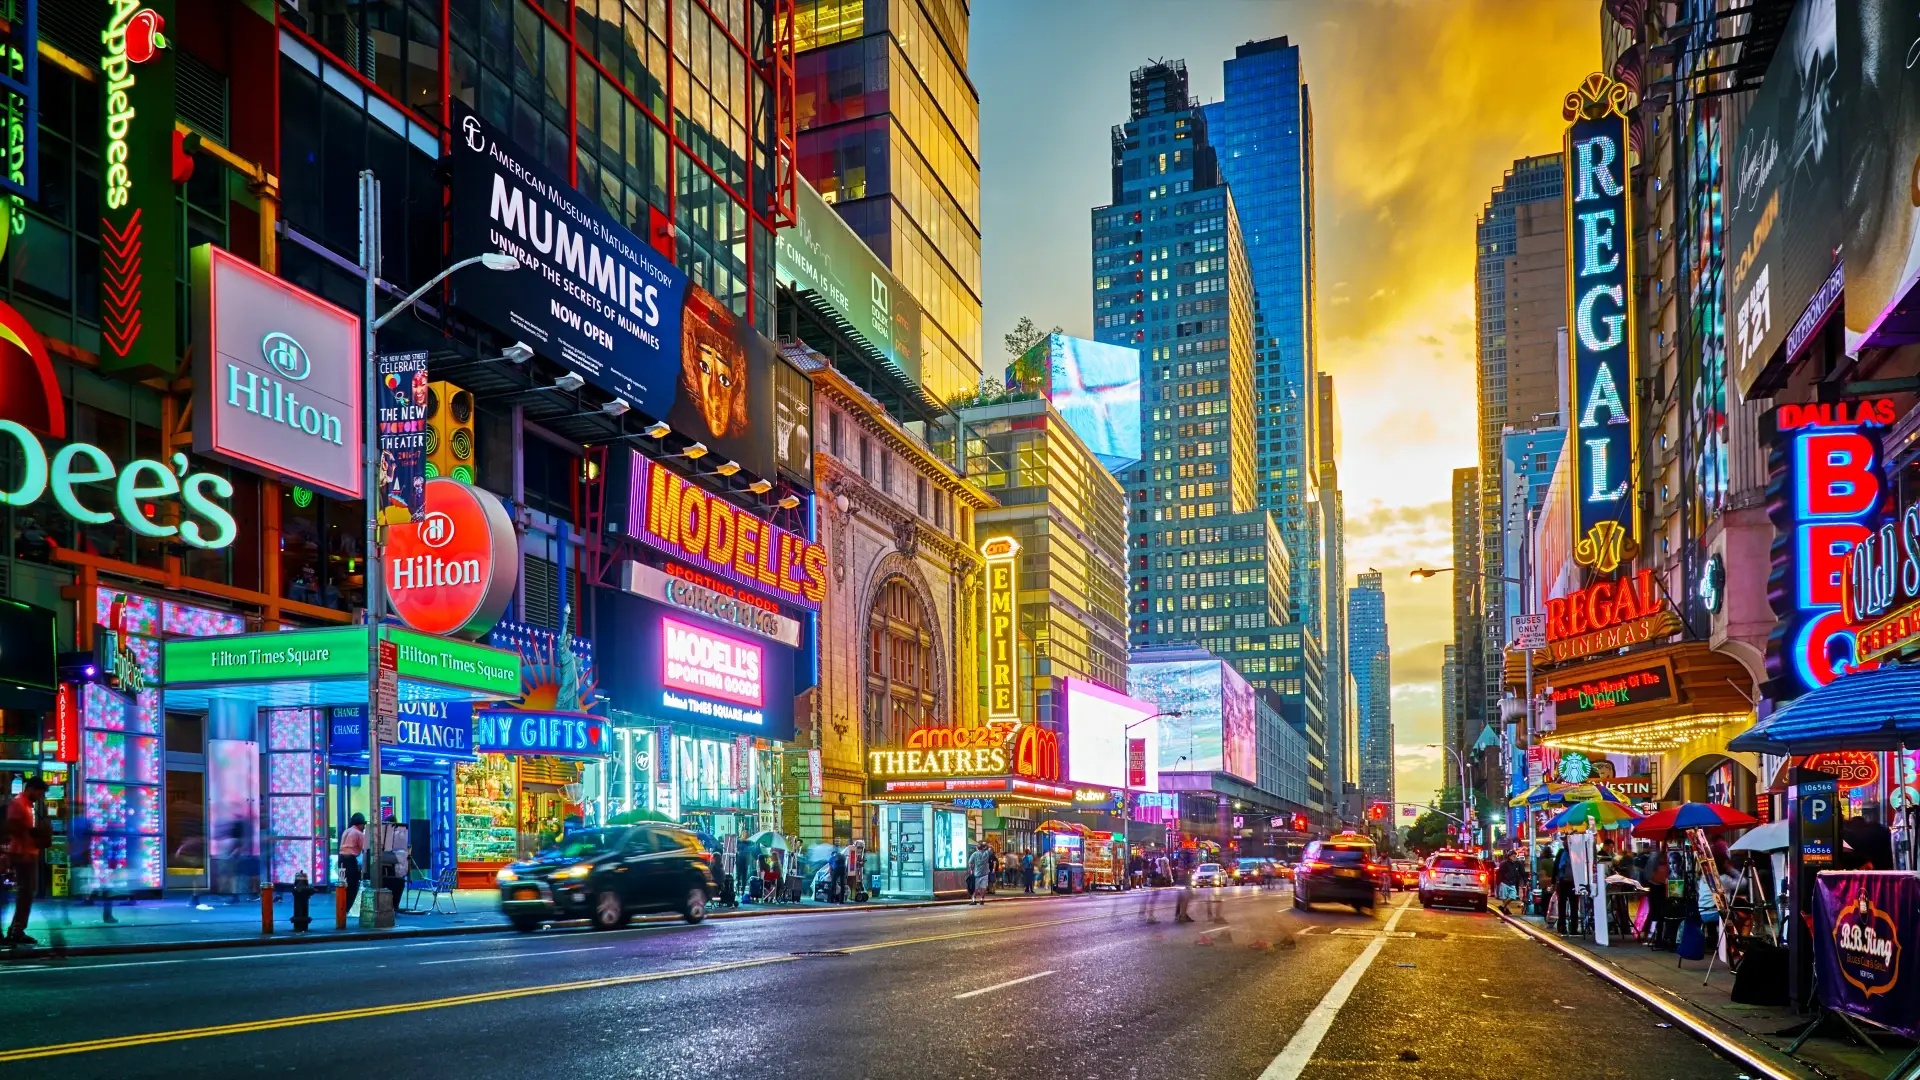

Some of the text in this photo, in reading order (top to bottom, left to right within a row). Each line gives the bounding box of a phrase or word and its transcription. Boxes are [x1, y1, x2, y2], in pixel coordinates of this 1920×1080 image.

[489, 141, 546, 197] AMERICAN
[548, 185, 592, 231] MUSEUM
[601, 225, 639, 267] NATURAL
[640, 255, 673, 289] HISTORY
[489, 173, 660, 328] MUMMIES
[490, 228, 660, 351] UNWRAP THE SECRETS OF MUMMIES
[786, 243, 818, 283] CINEMA
[820, 274, 828, 292] IS
[829, 282, 849, 312] HERE
[551, 299, 581, 331] NOW
[584, 320, 614, 351] OPEN
[871, 317, 889, 340] CINEMA
[1572, 135, 1630, 502] REGAL
[1738, 296, 1750, 332] NEW
[1738, 285, 1771, 372] 7.21
[1787, 288, 1827, 357] OUTFRONT
[380, 360, 426, 374] CELEBRATES
[412, 352, 426, 361] STREET
[227, 363, 343, 445] Hilton
[380, 406, 426, 422] THE NEW
[1778, 398, 1896, 431] DALLAS
[380, 420, 425, 433] VICTORY
[381, 437, 424, 450] THEATER
[650, 463, 828, 603] MODELL'S
[986, 542, 1012, 555] amc
[393, 555, 481, 590] Hilton
[1795, 431, 1882, 690] BBQ
[666, 562, 779, 614] SPORTING GOODS
[1544, 568, 1663, 642] REGAL
[1515, 616, 1541, 625] BUSES
[1518, 625, 1539, 633] ONLY
[667, 626, 760, 682] MODELL'S
[991, 567, 1012, 709] EMPIRE
[1557, 620, 1651, 660] CINEMAS
[212, 647, 330, 666] Hilton Times Square
[399, 644, 438, 666] Hilton
[439, 652, 475, 673] Times
[477, 660, 515, 681] Square
[667, 661, 760, 699] SPORTING GOODS
[1627, 675, 1641, 688] Of
[1640, 672, 1660, 685] The
[333, 707, 360, 718] CHANGE
[688, 698, 713, 716] TIMES
[712, 703, 743, 722] SQUARE
[1579, 688, 1630, 709] Dunkirk
[333, 724, 360, 735] CHANGE
[479, 717, 588, 750] NY GIFTS
[907, 726, 1005, 749] amc 25
[869, 748, 1005, 775] THEATRES
[1804, 783, 1832, 792] 106566
[1890, 748, 1920, 811] BQ
[1812, 799, 1827, 820] P
